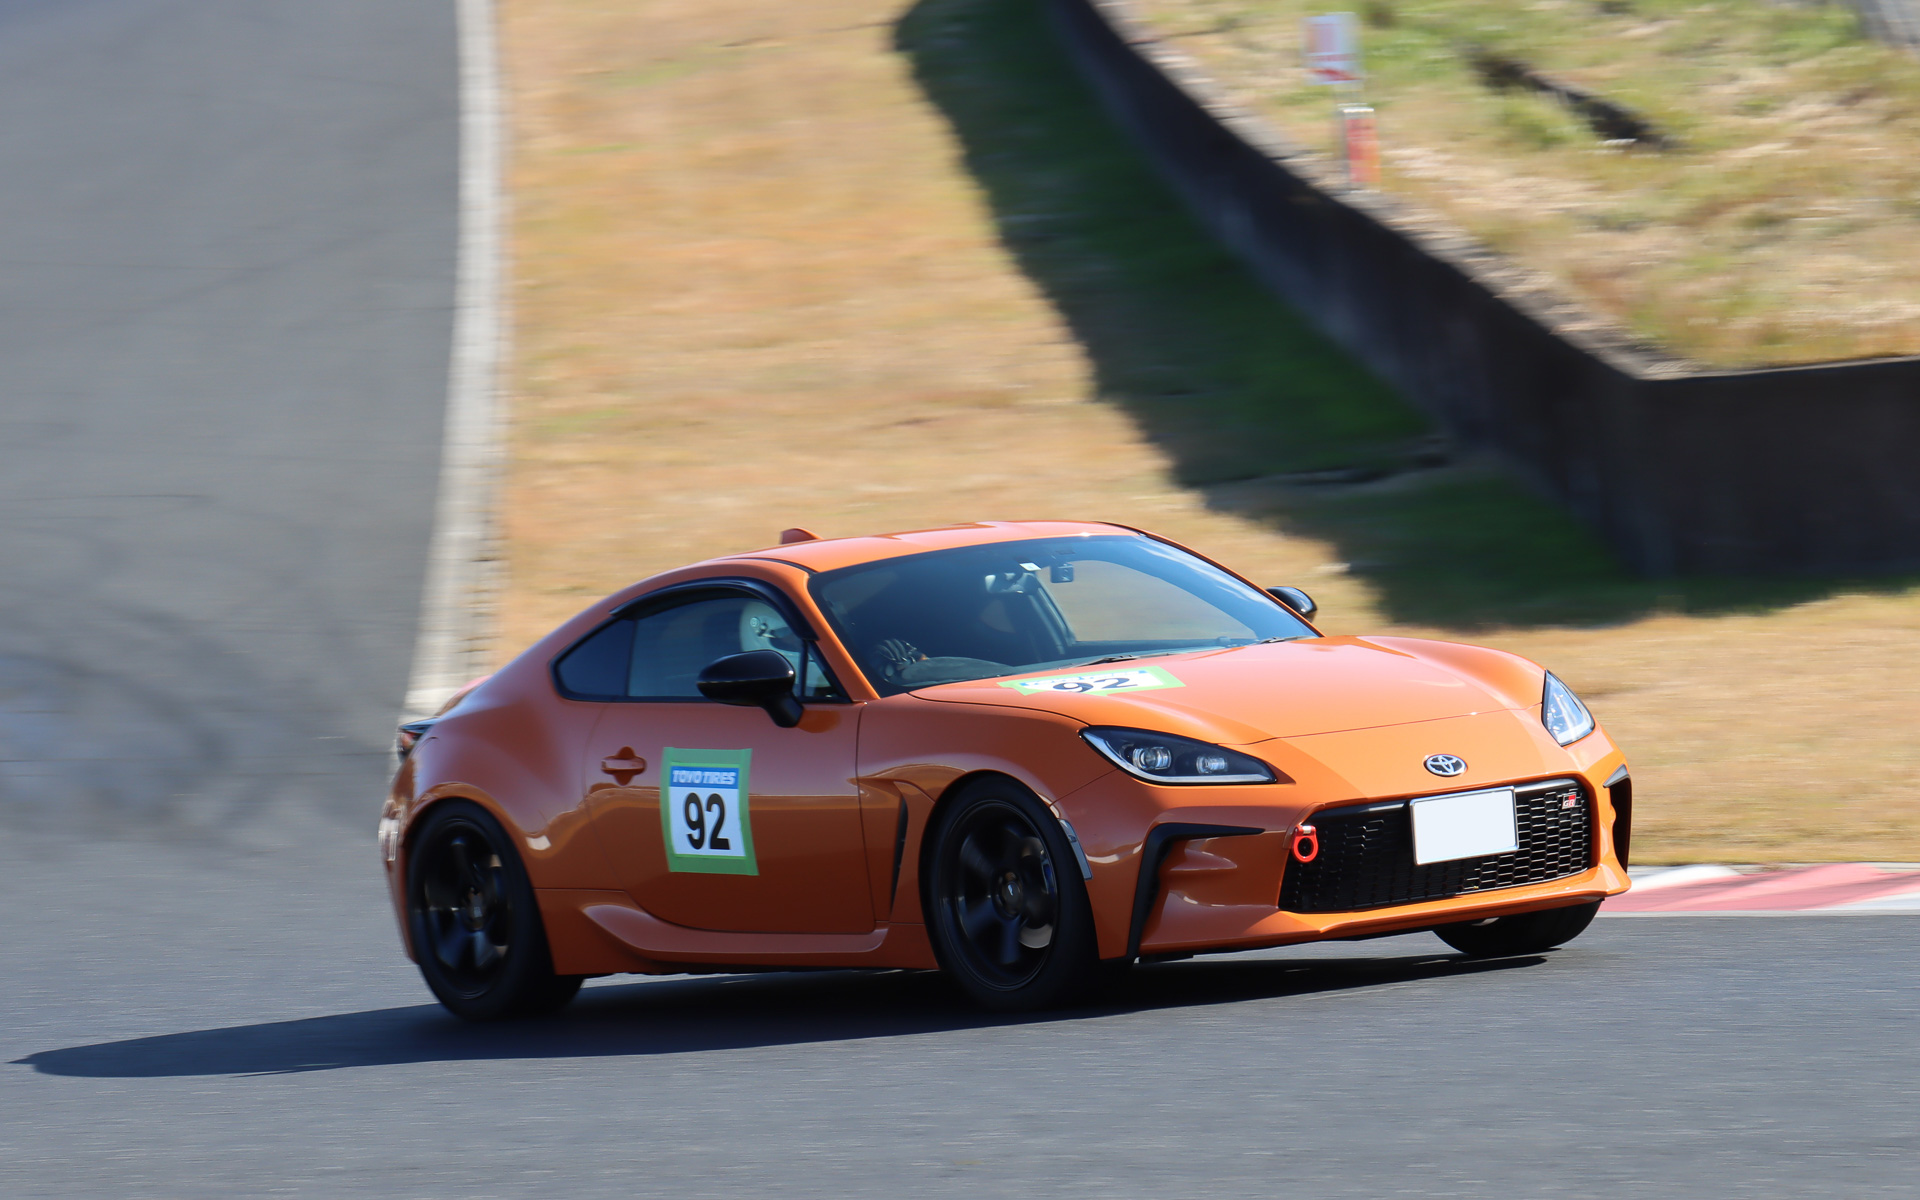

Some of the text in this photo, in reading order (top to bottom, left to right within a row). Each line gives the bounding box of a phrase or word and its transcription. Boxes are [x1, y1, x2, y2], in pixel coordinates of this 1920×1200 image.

[1052, 677, 1139, 693] 92
[672, 770, 737, 785] TOYO TIRES
[684, 792, 731, 850] 92
